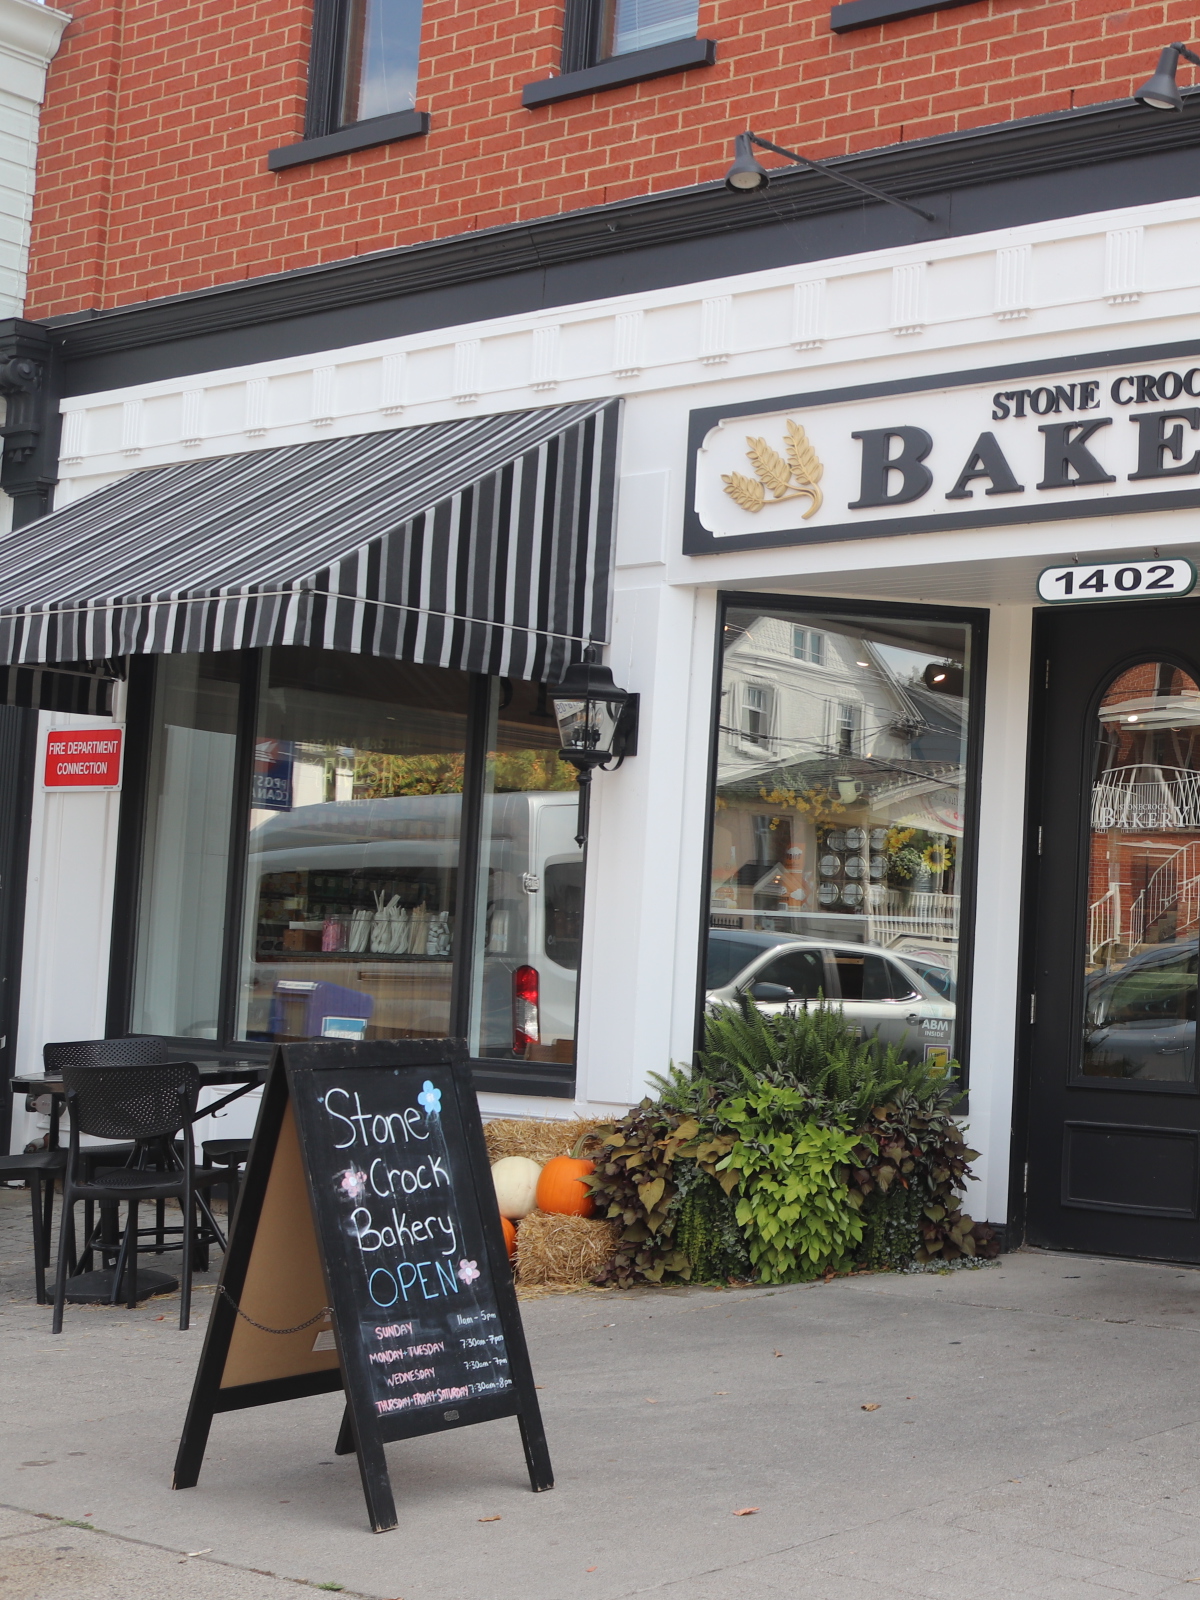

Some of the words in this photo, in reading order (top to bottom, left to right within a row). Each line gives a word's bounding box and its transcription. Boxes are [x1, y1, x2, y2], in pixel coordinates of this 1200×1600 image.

[992, 380, 1100, 421] STONE
[1054, 565, 1176, 596] 1402
[49, 742, 66, 755] FIRE
[67, 741, 119, 754] DEPARTMENT
[57, 762, 108, 775] CONNECTION
[322, 756, 394, 804] FRESH
[1100, 806, 1190, 828] BAKERY
[922, 1019, 949, 1031] ABM
[325, 1087, 430, 1148] Stone
[370, 1154, 450, 1198] Crock
[351, 1207, 457, 1256] Bakery
[369, 1259, 459, 1307] OPEN
[375, 1322, 413, 1340] SUNDAY
[480, 1310, 497, 1321] 5pm
[386, 1366, 436, 1387] WEDNESDAY
